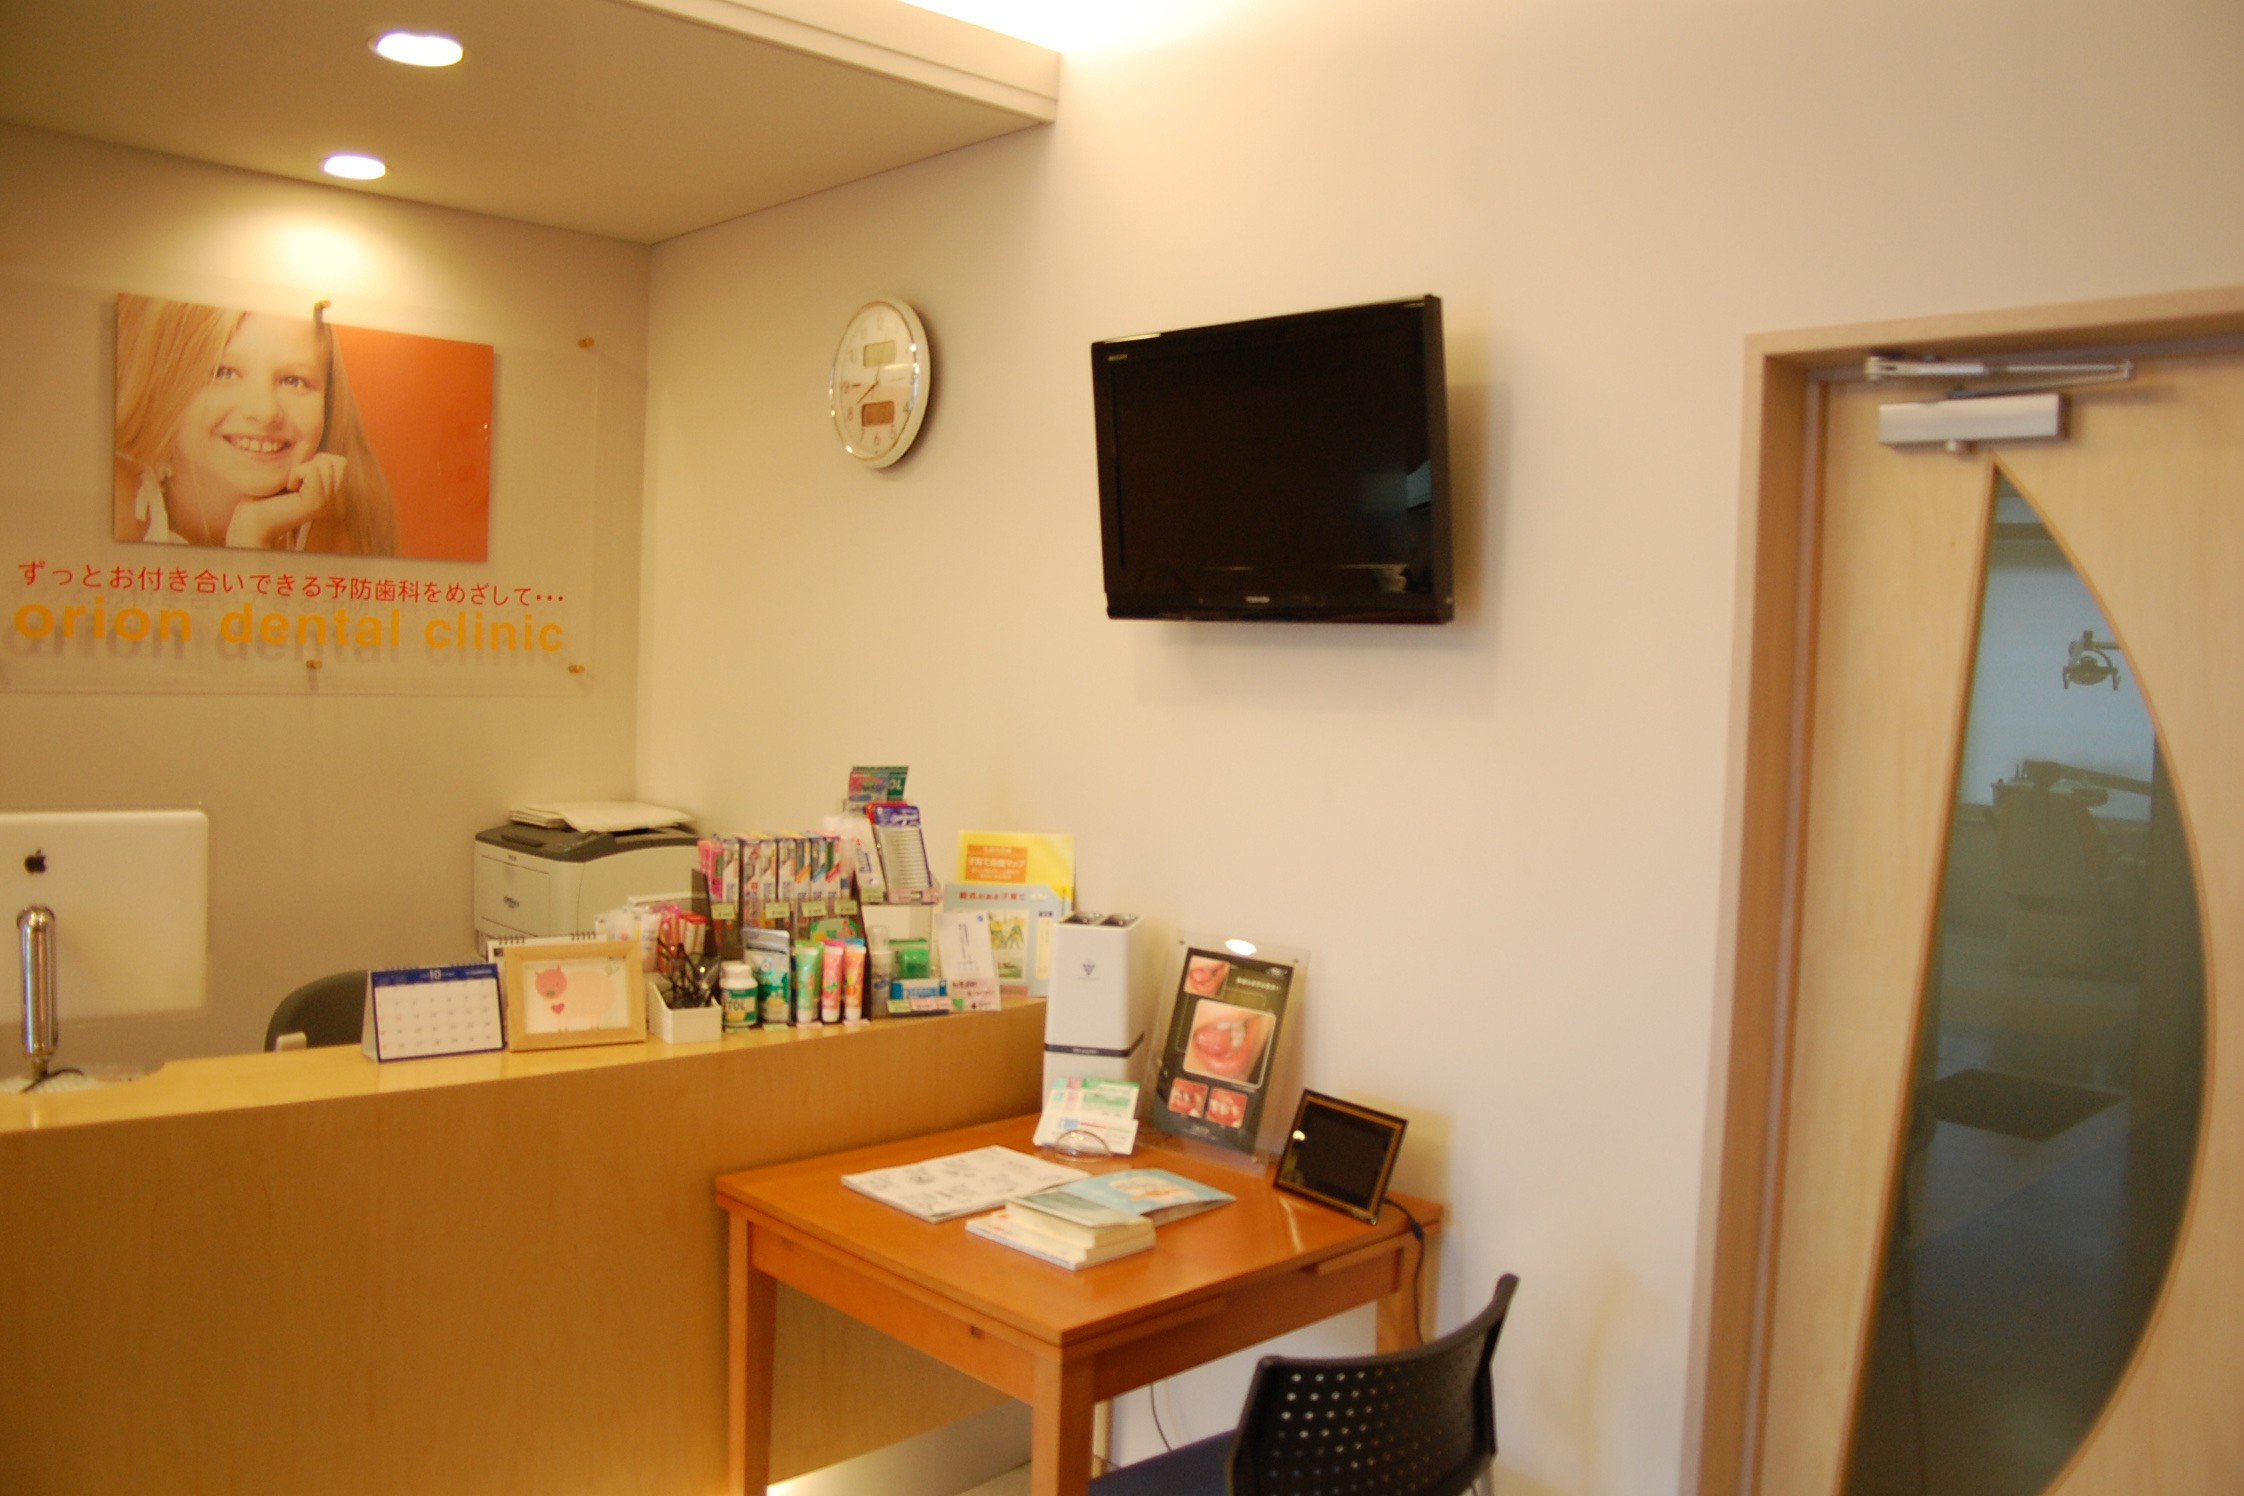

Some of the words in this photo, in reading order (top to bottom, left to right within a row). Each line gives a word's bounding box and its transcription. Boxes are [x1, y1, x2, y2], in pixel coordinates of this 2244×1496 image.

[15, 596, 192, 641] orion
[220, 602, 400, 648] dental
[424, 611, 564, 652] clinic
